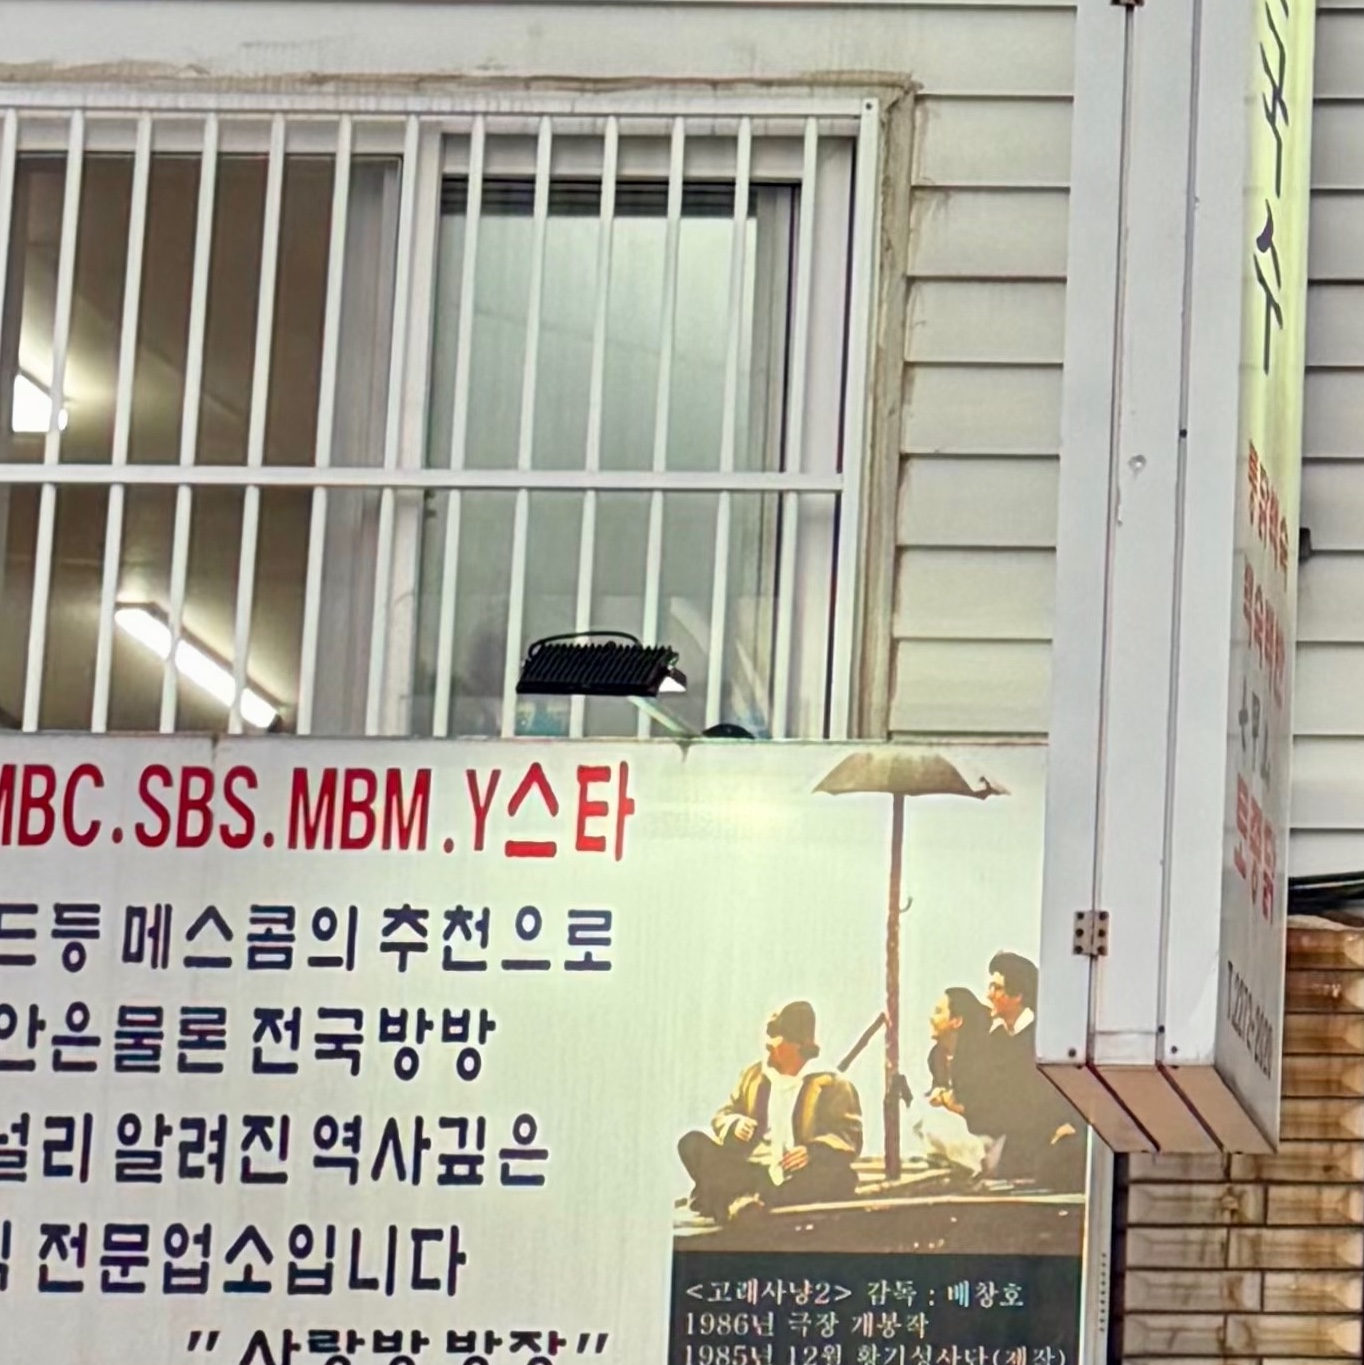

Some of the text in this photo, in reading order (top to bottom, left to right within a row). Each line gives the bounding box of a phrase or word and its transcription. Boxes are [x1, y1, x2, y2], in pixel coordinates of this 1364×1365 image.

[122, 903, 358, 971] 메스콤의
[380, 904, 613, 972] 추천으로
[251, 1005, 497, 1081] 전국방방
[114, 1113, 291, 1185] 알려진
[312, 1112, 550, 1187] 역사깊은
[37, 1223, 468, 1297] 전문업소입니다
[686, 1278, 853, 1306] <고래사냥2>
[866, 1280, 918, 1307] 감독
[946, 1280, 1025, 1308] 배창호
[686, 1312, 930, 1340] 1986년 극장 개봉작
